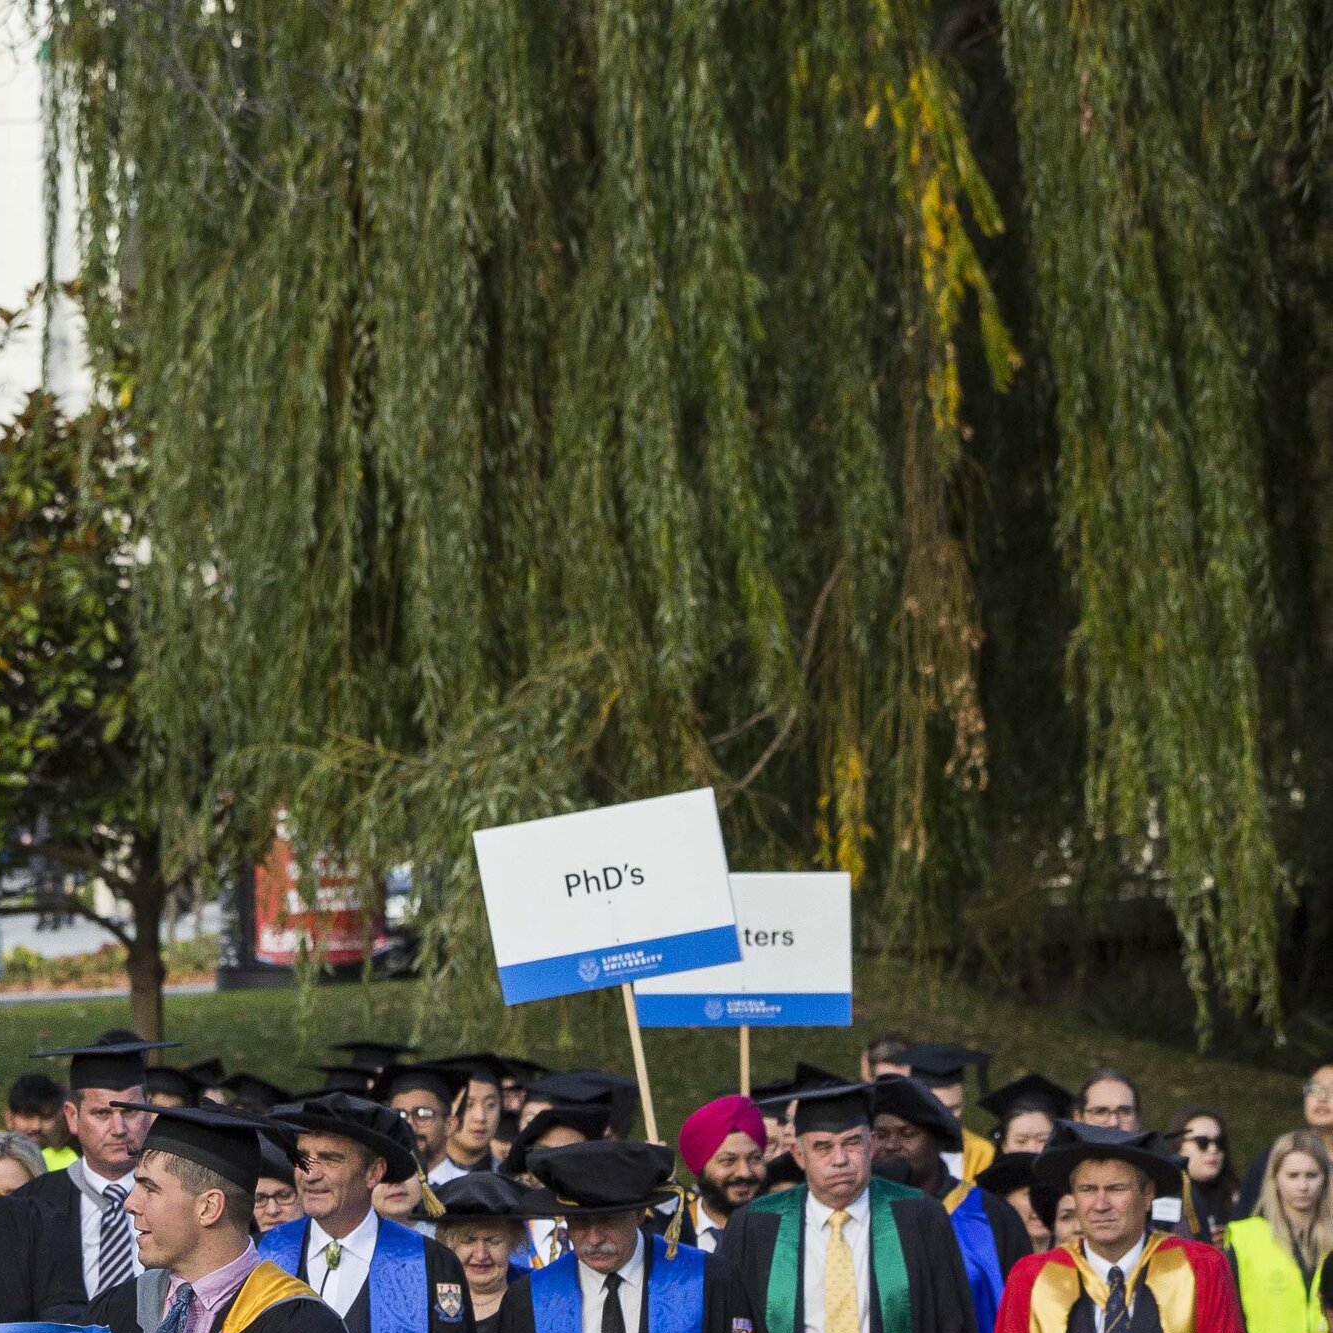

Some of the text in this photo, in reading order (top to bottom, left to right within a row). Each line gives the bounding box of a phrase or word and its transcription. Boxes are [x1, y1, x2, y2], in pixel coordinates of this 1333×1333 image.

[564, 863, 645, 897] PhD's
[744, 928, 795, 947] ters
[601, 949, 644, 965] LINCOLN
[602, 953, 663, 971] UNIVERSITY
